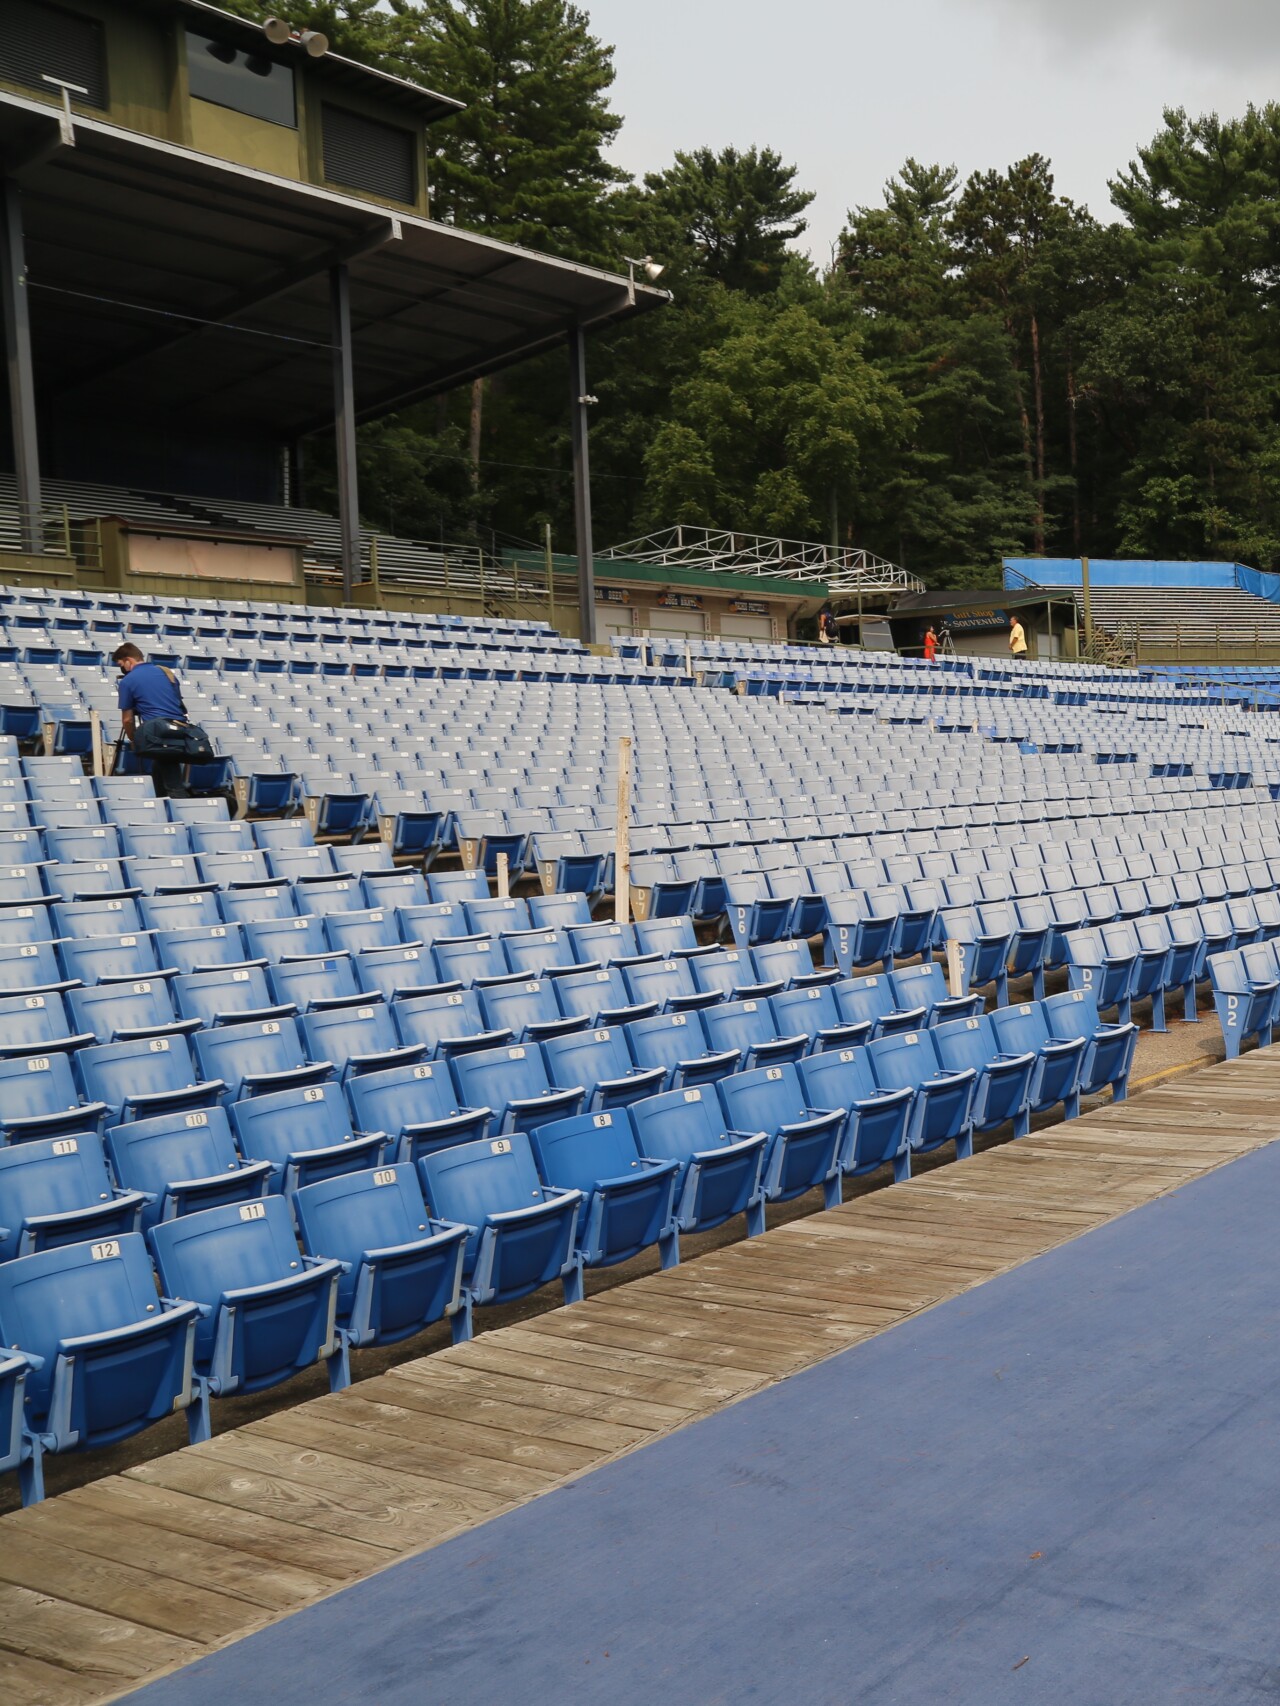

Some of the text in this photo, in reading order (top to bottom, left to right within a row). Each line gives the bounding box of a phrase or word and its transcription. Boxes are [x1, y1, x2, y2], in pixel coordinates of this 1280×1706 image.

[952, 609, 995, 619] Gift Shop
[952, 616, 1005, 628] SOUVENIRS
[239, 779, 246, 789] D
[238, 790, 247, 800] 12
[310, 798, 316, 809] D
[308, 810, 316, 821] 11
[385, 817, 392, 828] D
[383, 830, 393, 841] 10
[466, 840, 473, 851] D
[466, 853, 473, 864] 9
[545, 862, 553, 873] D
[545, 875, 553, 887] 8
[192, 895, 198, 903] 5
[638, 889, 646, 901] D
[112, 902, 118, 910] 6
[443, 906, 449, 914] 3
[637, 902, 646, 914] 7
[737, 907, 746, 919] D
[298, 919, 304, 928] 5
[738, 921, 746, 934] 6
[215, 928, 221, 936] 6
[840, 927, 849, 940] D
[26, 946, 32, 955] 8
[840, 942, 849, 954] 5
[407, 950, 414, 960] 5
[667, 962, 673, 970] 3
[1082, 968, 1093, 982] D
[139, 984, 146, 993] 8
[529, 983, 536, 992] 5
[811, 990, 817, 998] 3
[31, 998, 38, 1007] 9
[451, 995, 458, 1004] 6
[1227, 995, 1239, 1009] D
[676, 1016, 682, 1025] 5
[1227, 1012, 1237, 1026] 2
[267, 1023, 274, 1033] 8
[970, 1020, 975, 1029] 3
[599, 1031, 606, 1041] 6
[156, 1040, 162, 1050] 9
[843, 1051, 850, 1061] 5
[33, 1059, 45, 1070] 10
[419, 1067, 426, 1077] 8
[771, 1069, 778, 1079] 6
[310, 1090, 317, 1100] 9
[689, 1091, 695, 1100] 7
[190, 1114, 203, 1125] 10
[599, 1115, 606, 1126] 8
[59, 1141, 71, 1153] 11
[497, 1141, 505, 1152] 9
[378, 1171, 392, 1183] 10
[246, 1205, 259, 1218] 11
[97, 1243, 114, 1258] 12
